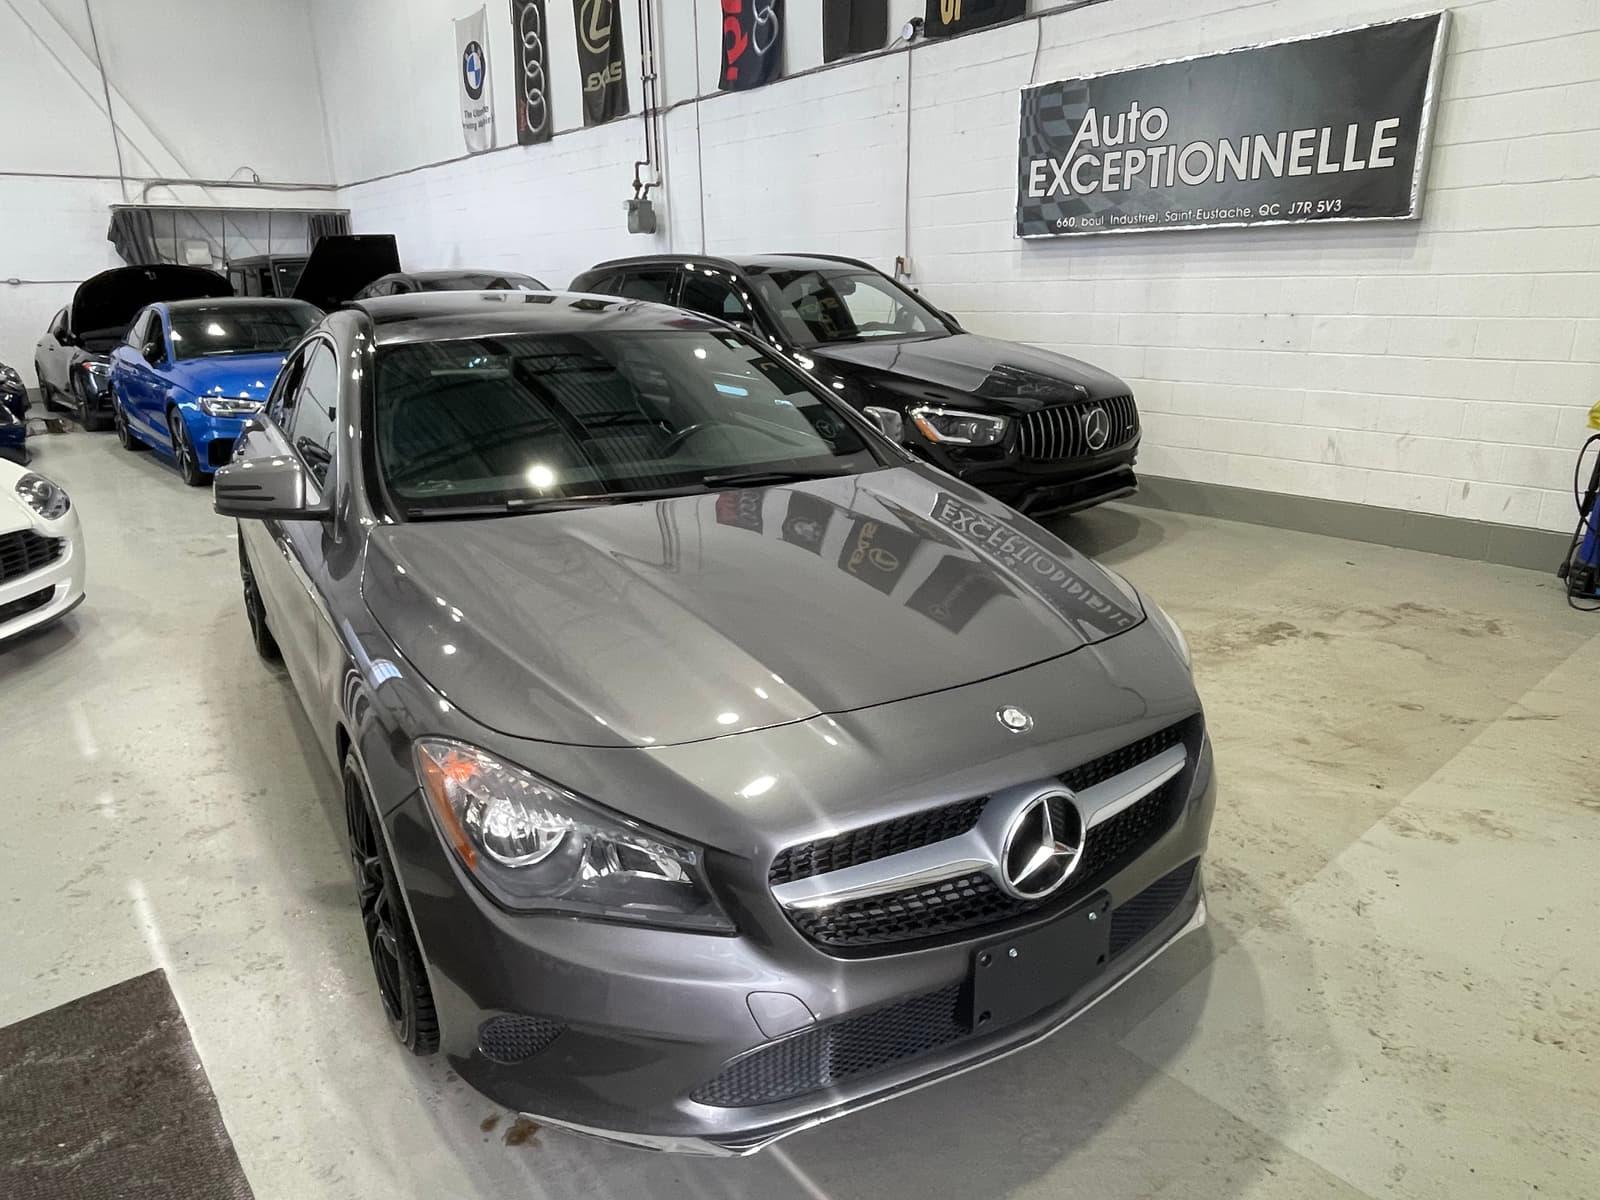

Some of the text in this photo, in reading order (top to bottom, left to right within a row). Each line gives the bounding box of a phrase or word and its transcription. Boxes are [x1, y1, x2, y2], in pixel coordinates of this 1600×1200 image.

[1072, 101, 1169, 148] Auto
[1028, 117, 1400, 198] EXCEPTIONNELLE
[1258, 203, 1281, 216] QC
[1288, 201, 1313, 215] J7R
[1316, 199, 1342, 213] 5V3
